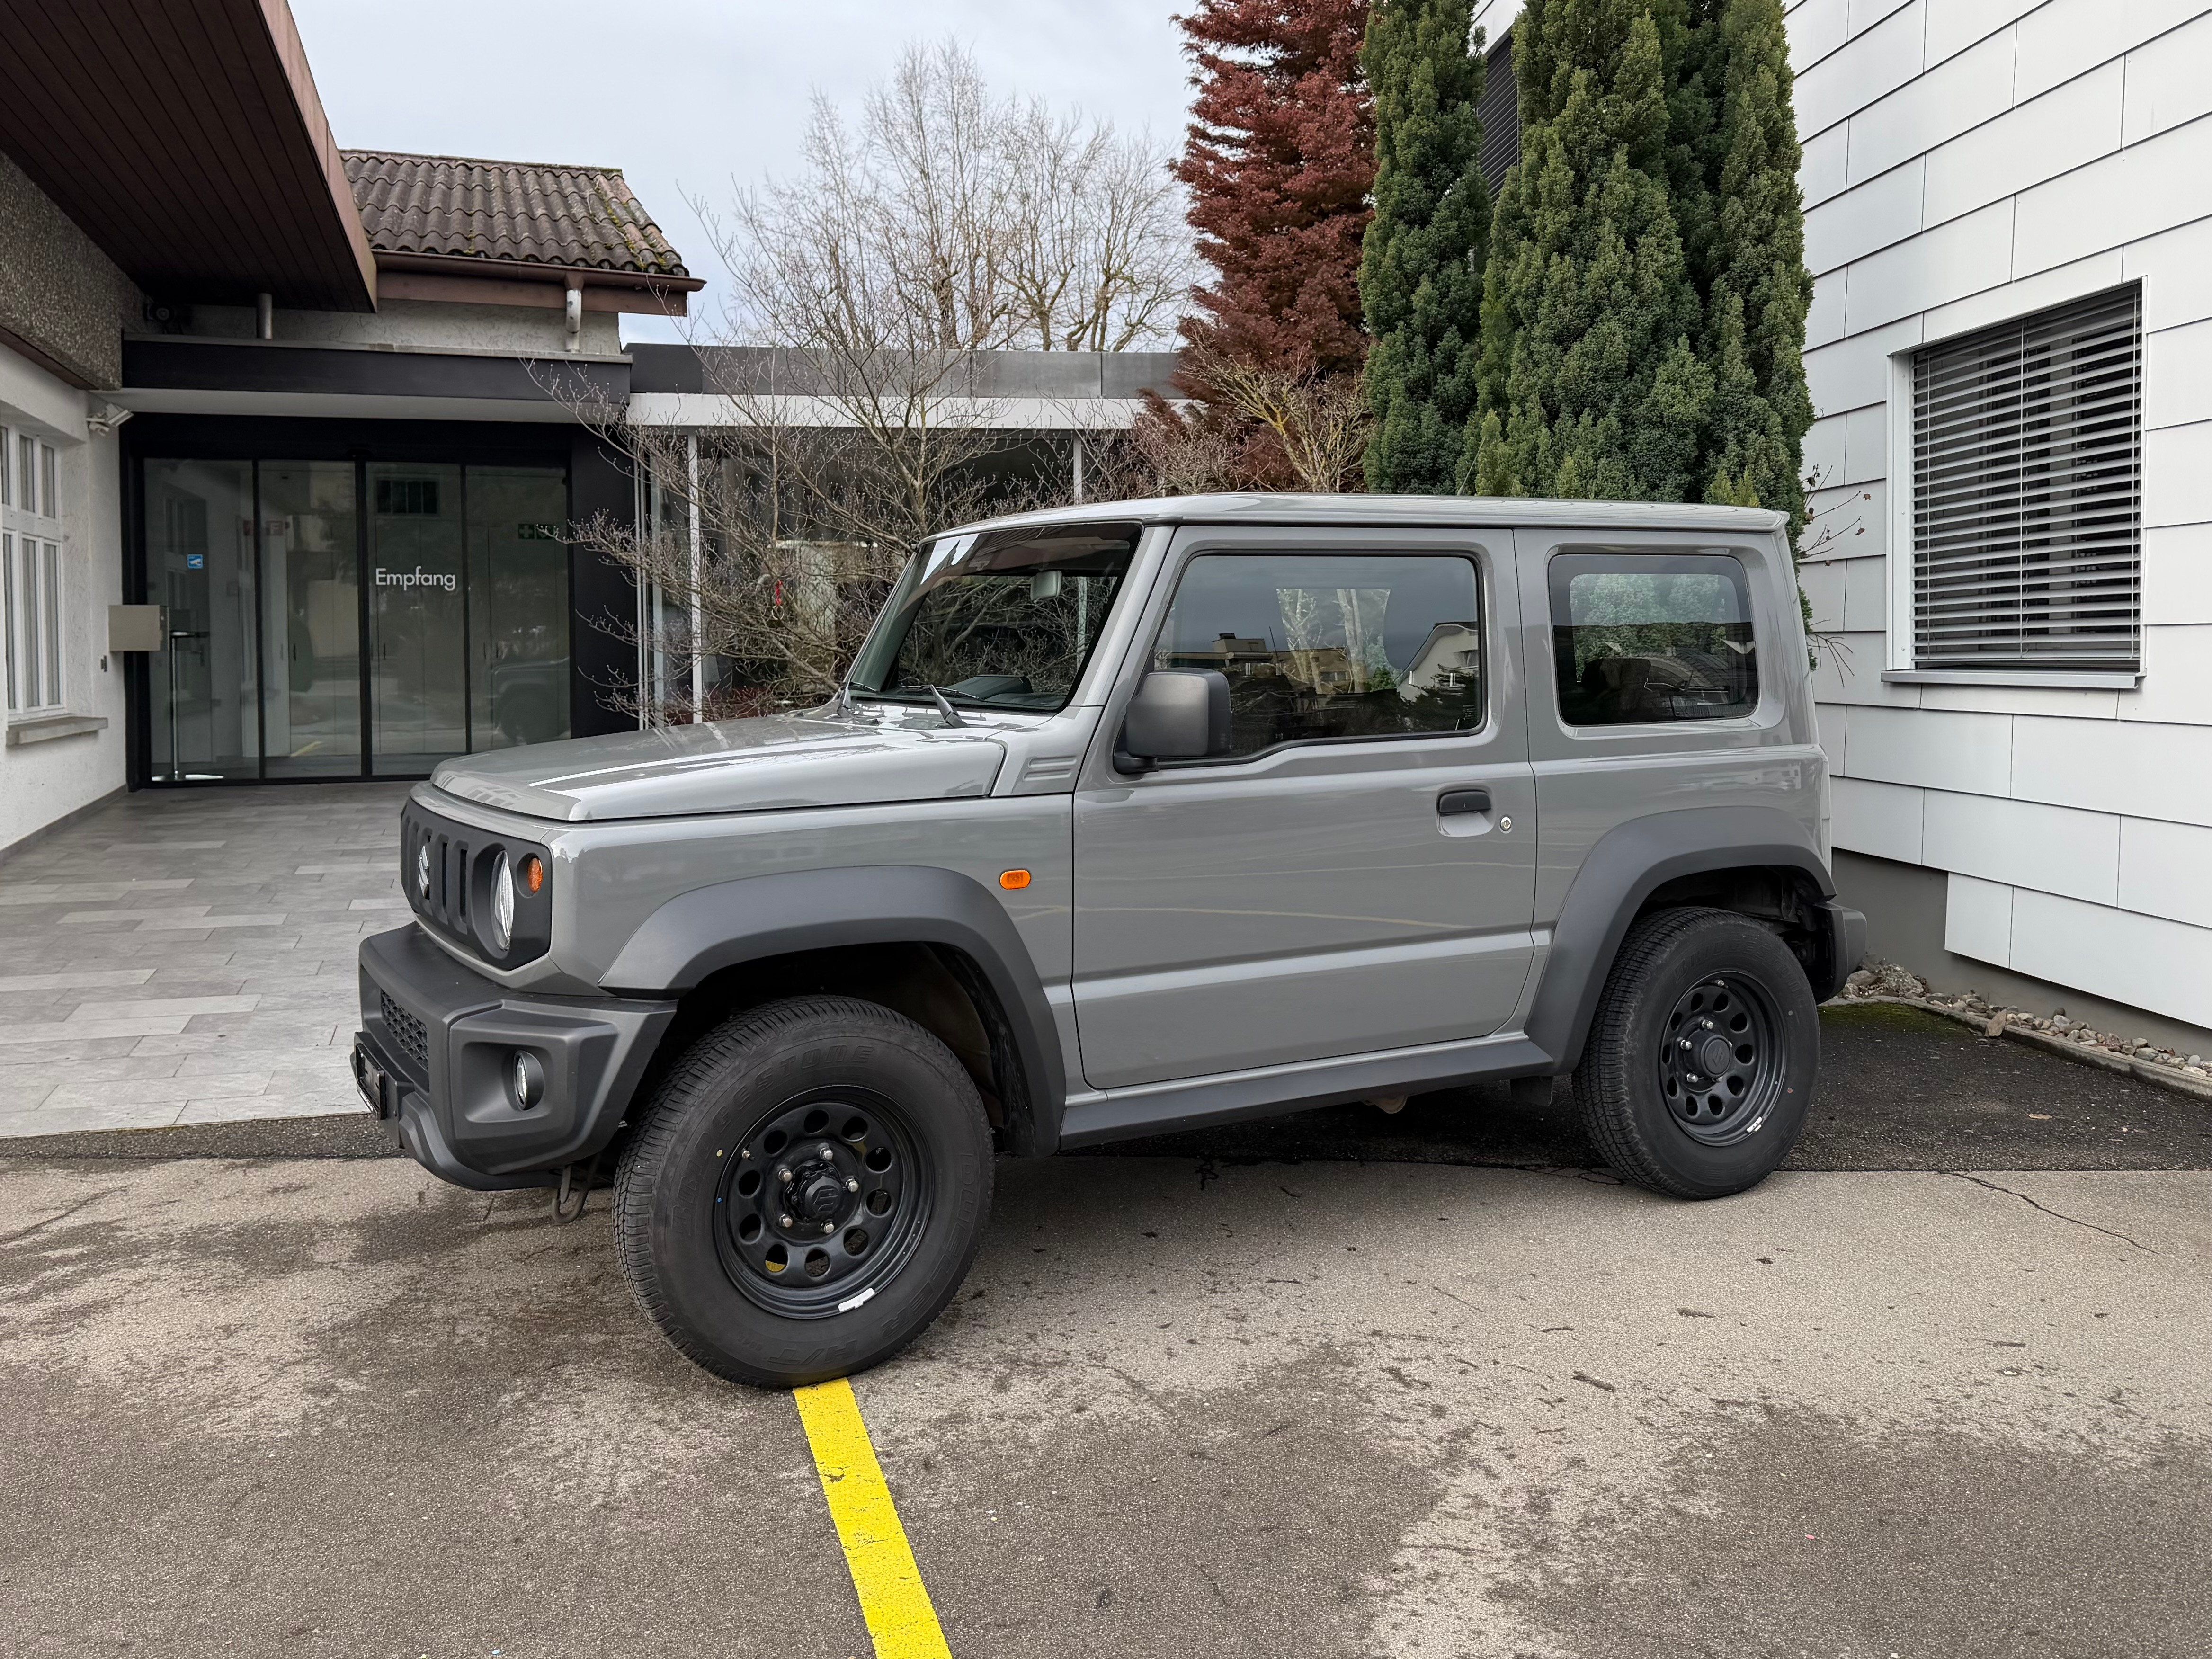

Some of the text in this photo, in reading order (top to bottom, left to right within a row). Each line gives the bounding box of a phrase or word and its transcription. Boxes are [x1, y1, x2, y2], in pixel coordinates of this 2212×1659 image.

[375, 565, 455, 591] Empfang
[670, 1044, 875, 1237] BRIDGESTONE
[880, 1153, 976, 1340] DUELER
[767, 1339, 857, 1366] H/T
